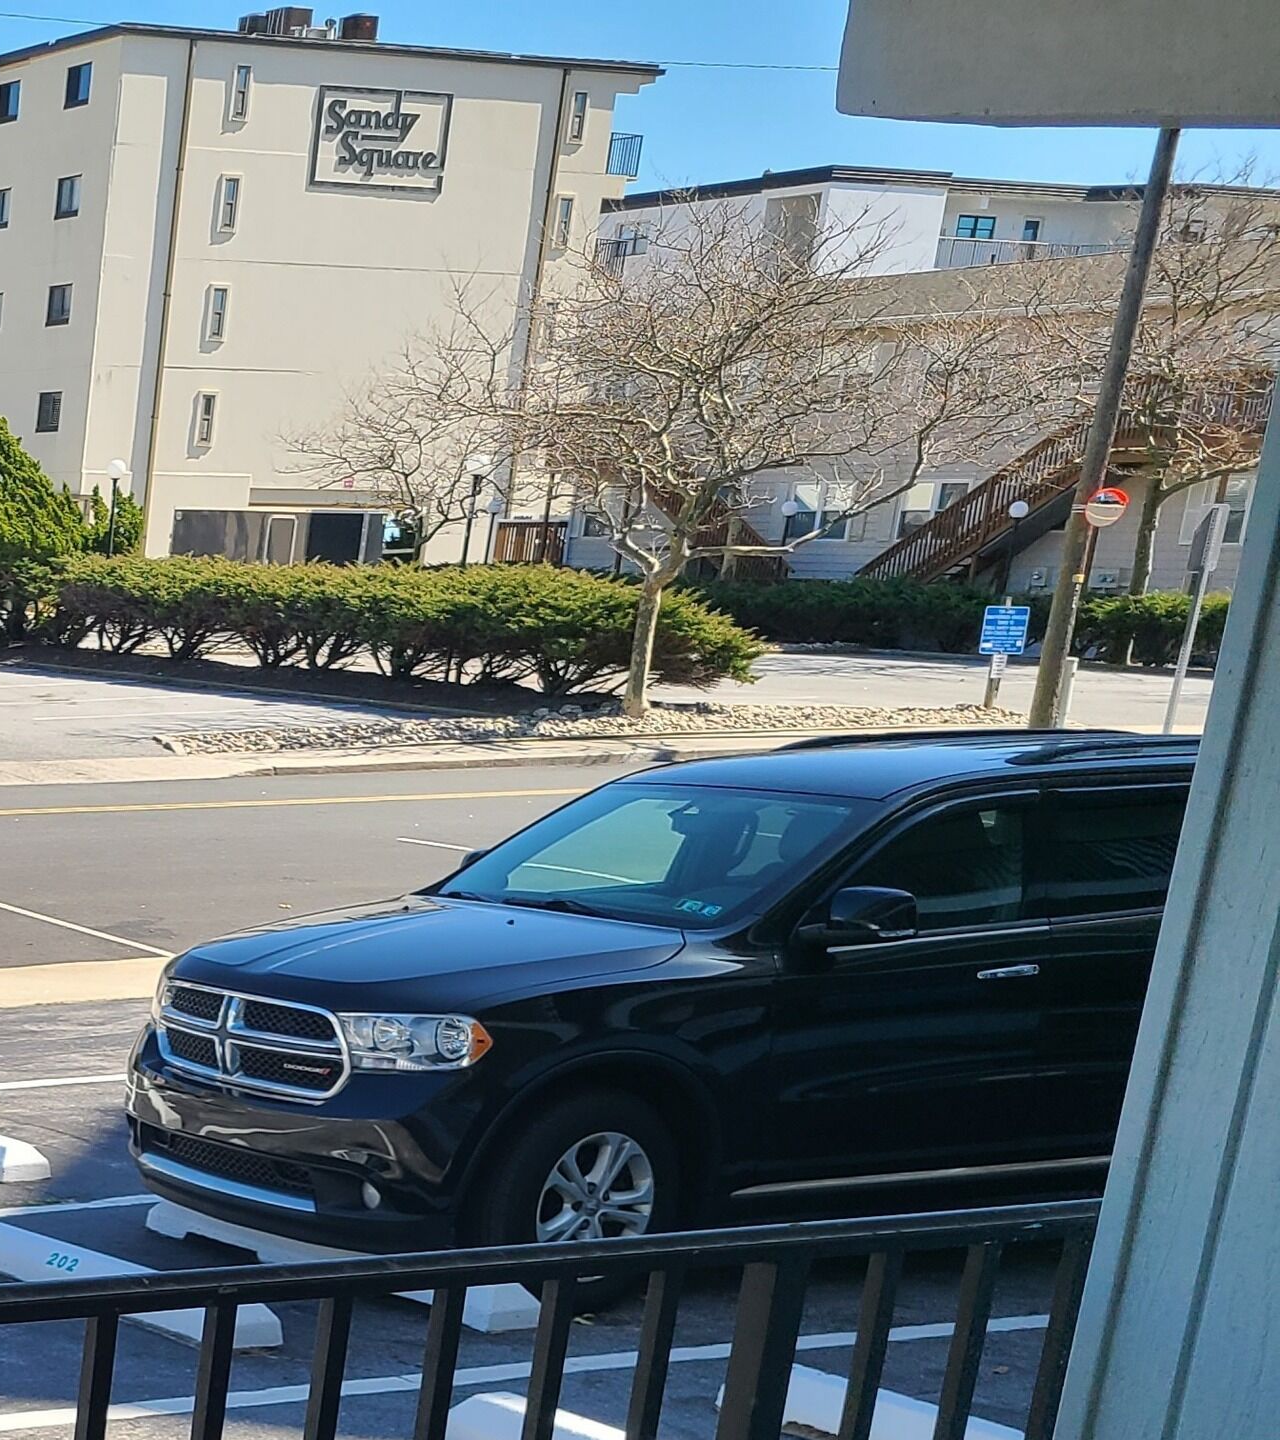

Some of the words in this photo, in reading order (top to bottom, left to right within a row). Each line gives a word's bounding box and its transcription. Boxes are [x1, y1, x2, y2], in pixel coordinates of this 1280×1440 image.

[325, 99, 421, 142] Sandy
[338, 130, 440, 176] Square
[283, 1063, 321, 1073] DODGE
[46, 1252, 79, 1273] 202
